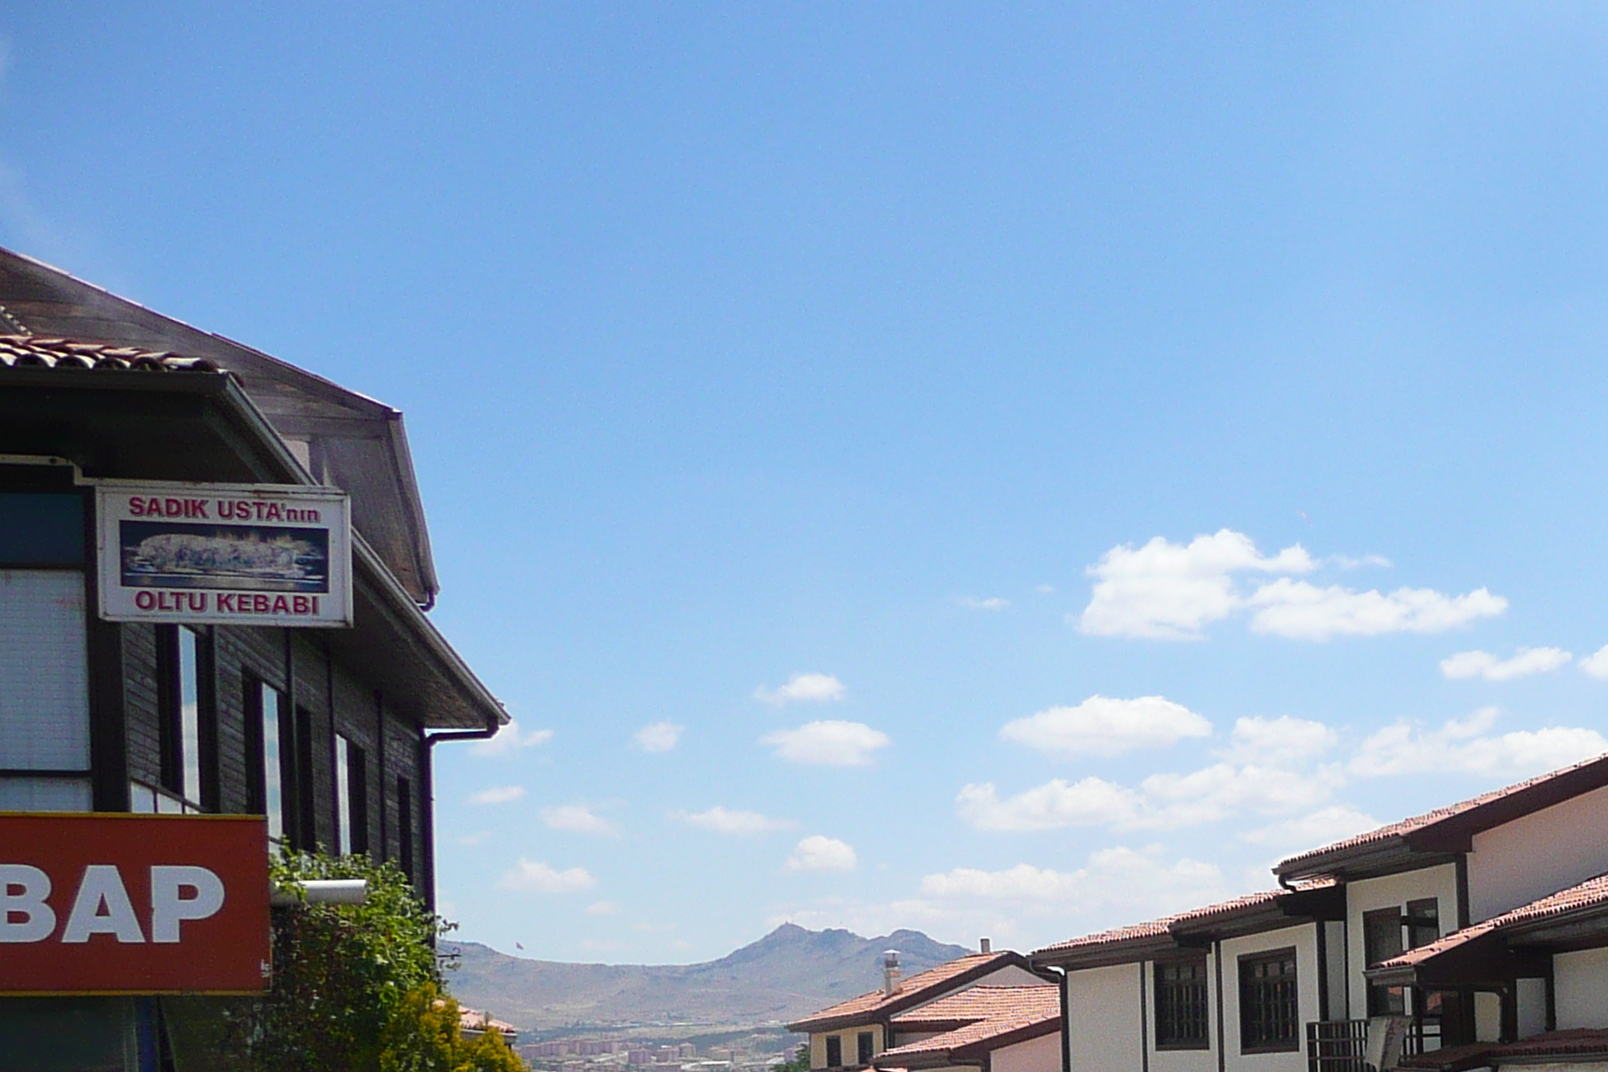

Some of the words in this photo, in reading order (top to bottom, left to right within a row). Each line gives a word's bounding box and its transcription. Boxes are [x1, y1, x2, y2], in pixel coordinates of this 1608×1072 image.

[129, 497, 209, 519] SADIK
[135, 591, 208, 612] OLTU
[216, 593, 321, 616] KEBABI
